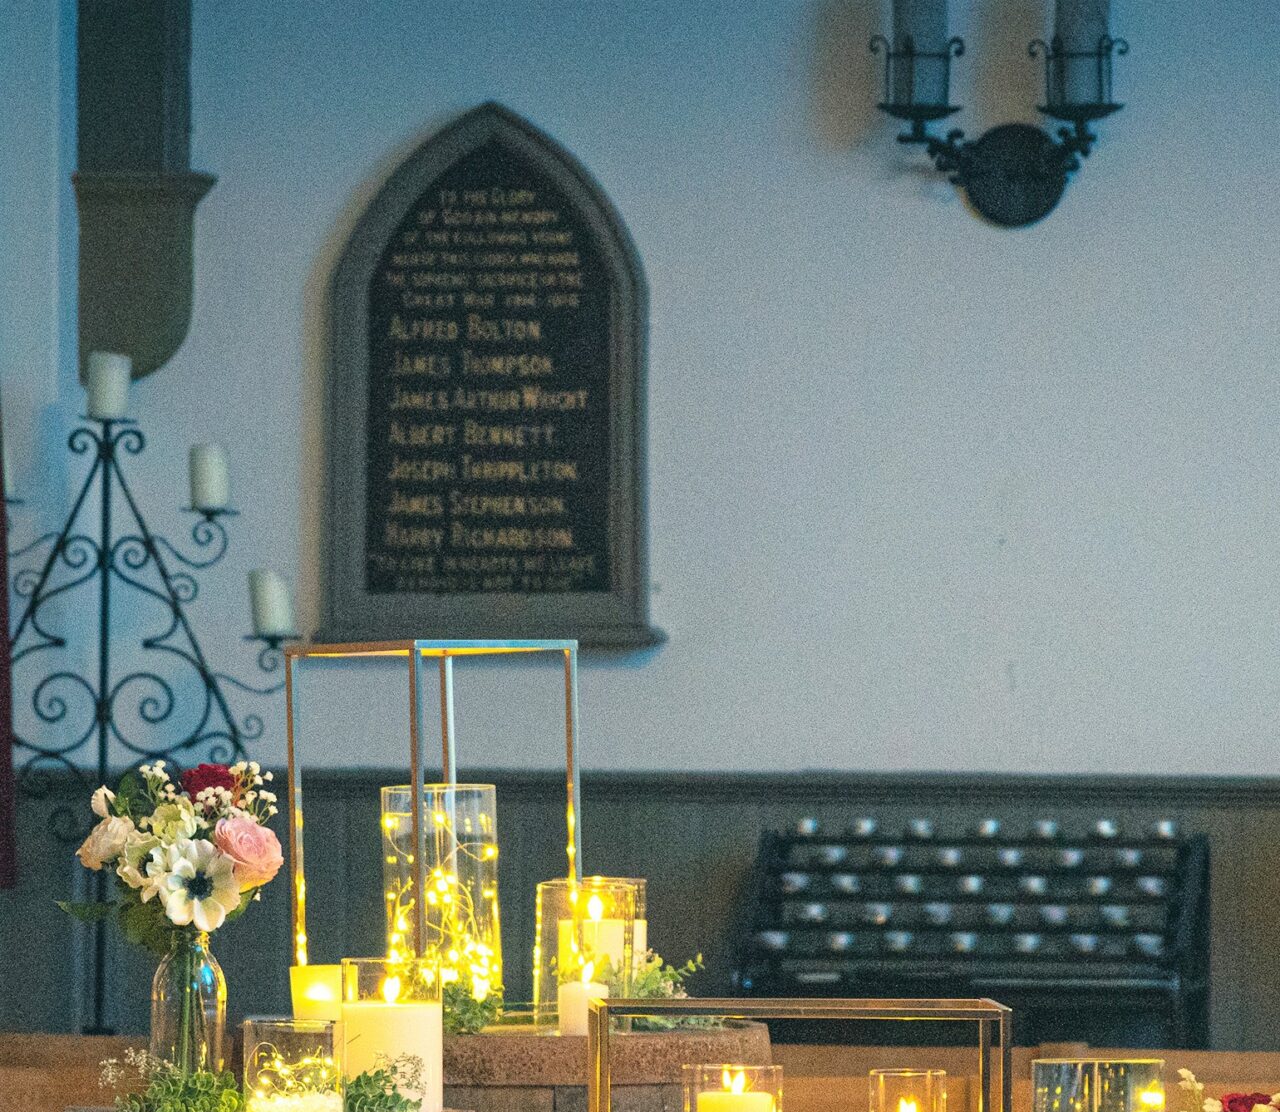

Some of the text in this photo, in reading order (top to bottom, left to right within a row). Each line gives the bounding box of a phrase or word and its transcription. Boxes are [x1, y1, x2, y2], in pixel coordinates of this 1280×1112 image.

[389, 313, 542, 340] ALFRED BOLTON
[389, 348, 553, 377] JAMES THOMPSON
[389, 386, 448, 411] JAMES
[450, 386, 521, 411] ARTHUR
[389, 420, 555, 446] ALBERT BENNETT
[387, 455, 457, 481] JOSEPH
[387, 490, 565, 516] JAMES STEPHENSON
[451, 521, 573, 548] RICHARDSON
